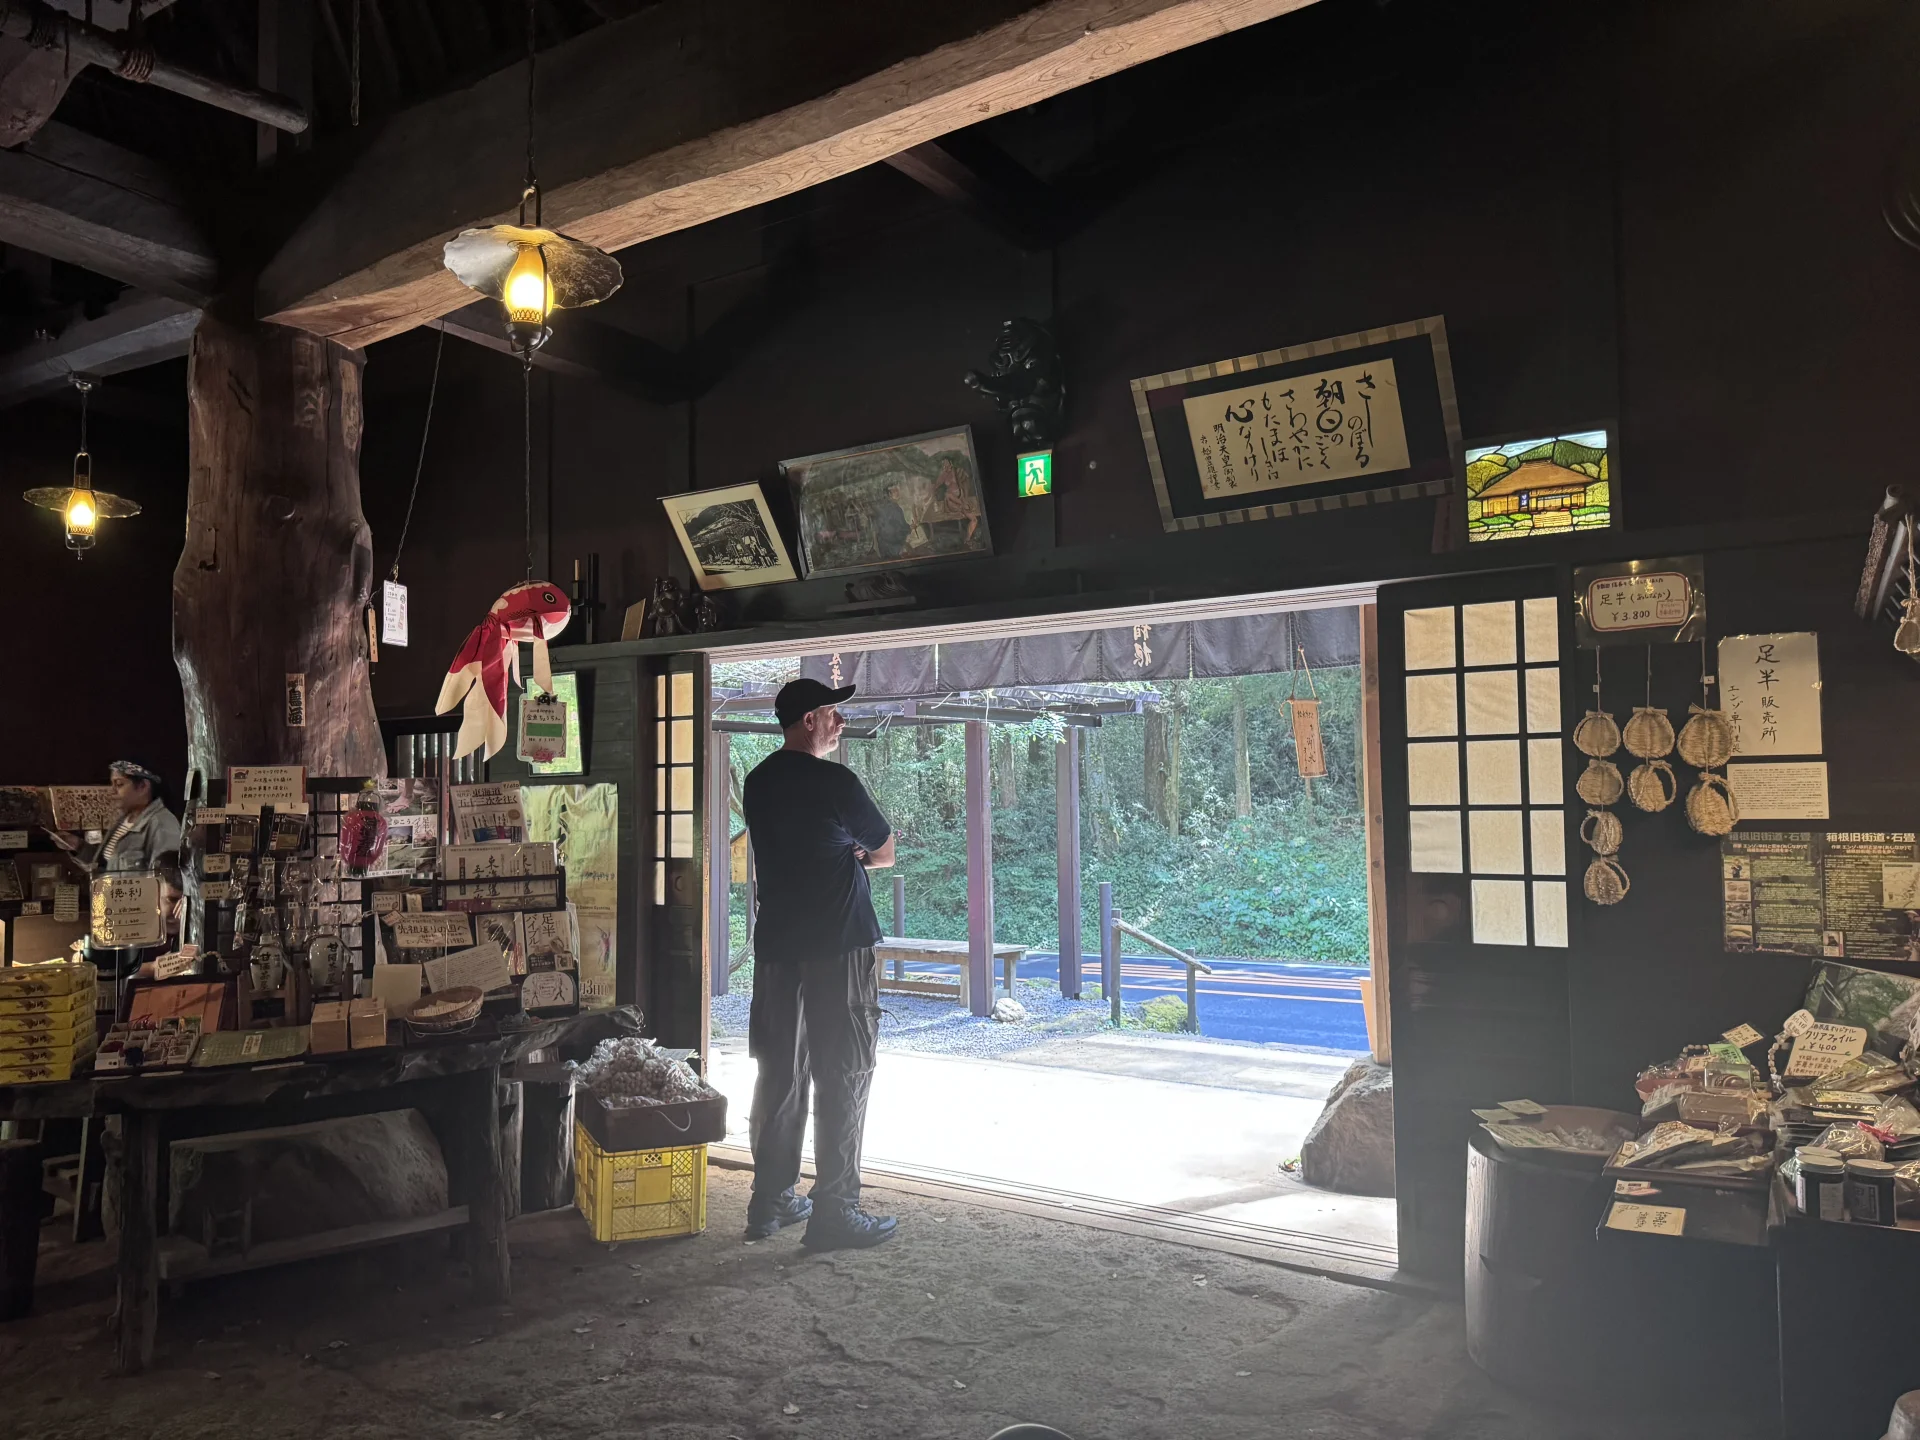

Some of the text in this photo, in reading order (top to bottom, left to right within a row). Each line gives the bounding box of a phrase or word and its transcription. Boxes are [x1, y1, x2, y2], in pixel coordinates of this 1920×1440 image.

[1755, 643, 1781, 745] 足半販売所
[1825, 832, 1916, 843] 箱根旧街道・石畳
[526, 914, 540, 946] バイブル
[541, 914, 556, 937] 足半
[1805, 1030, 1857, 1043] クリアファイル
[1811, 1023, 1857, 1034] 酒茶屋オリジナル
